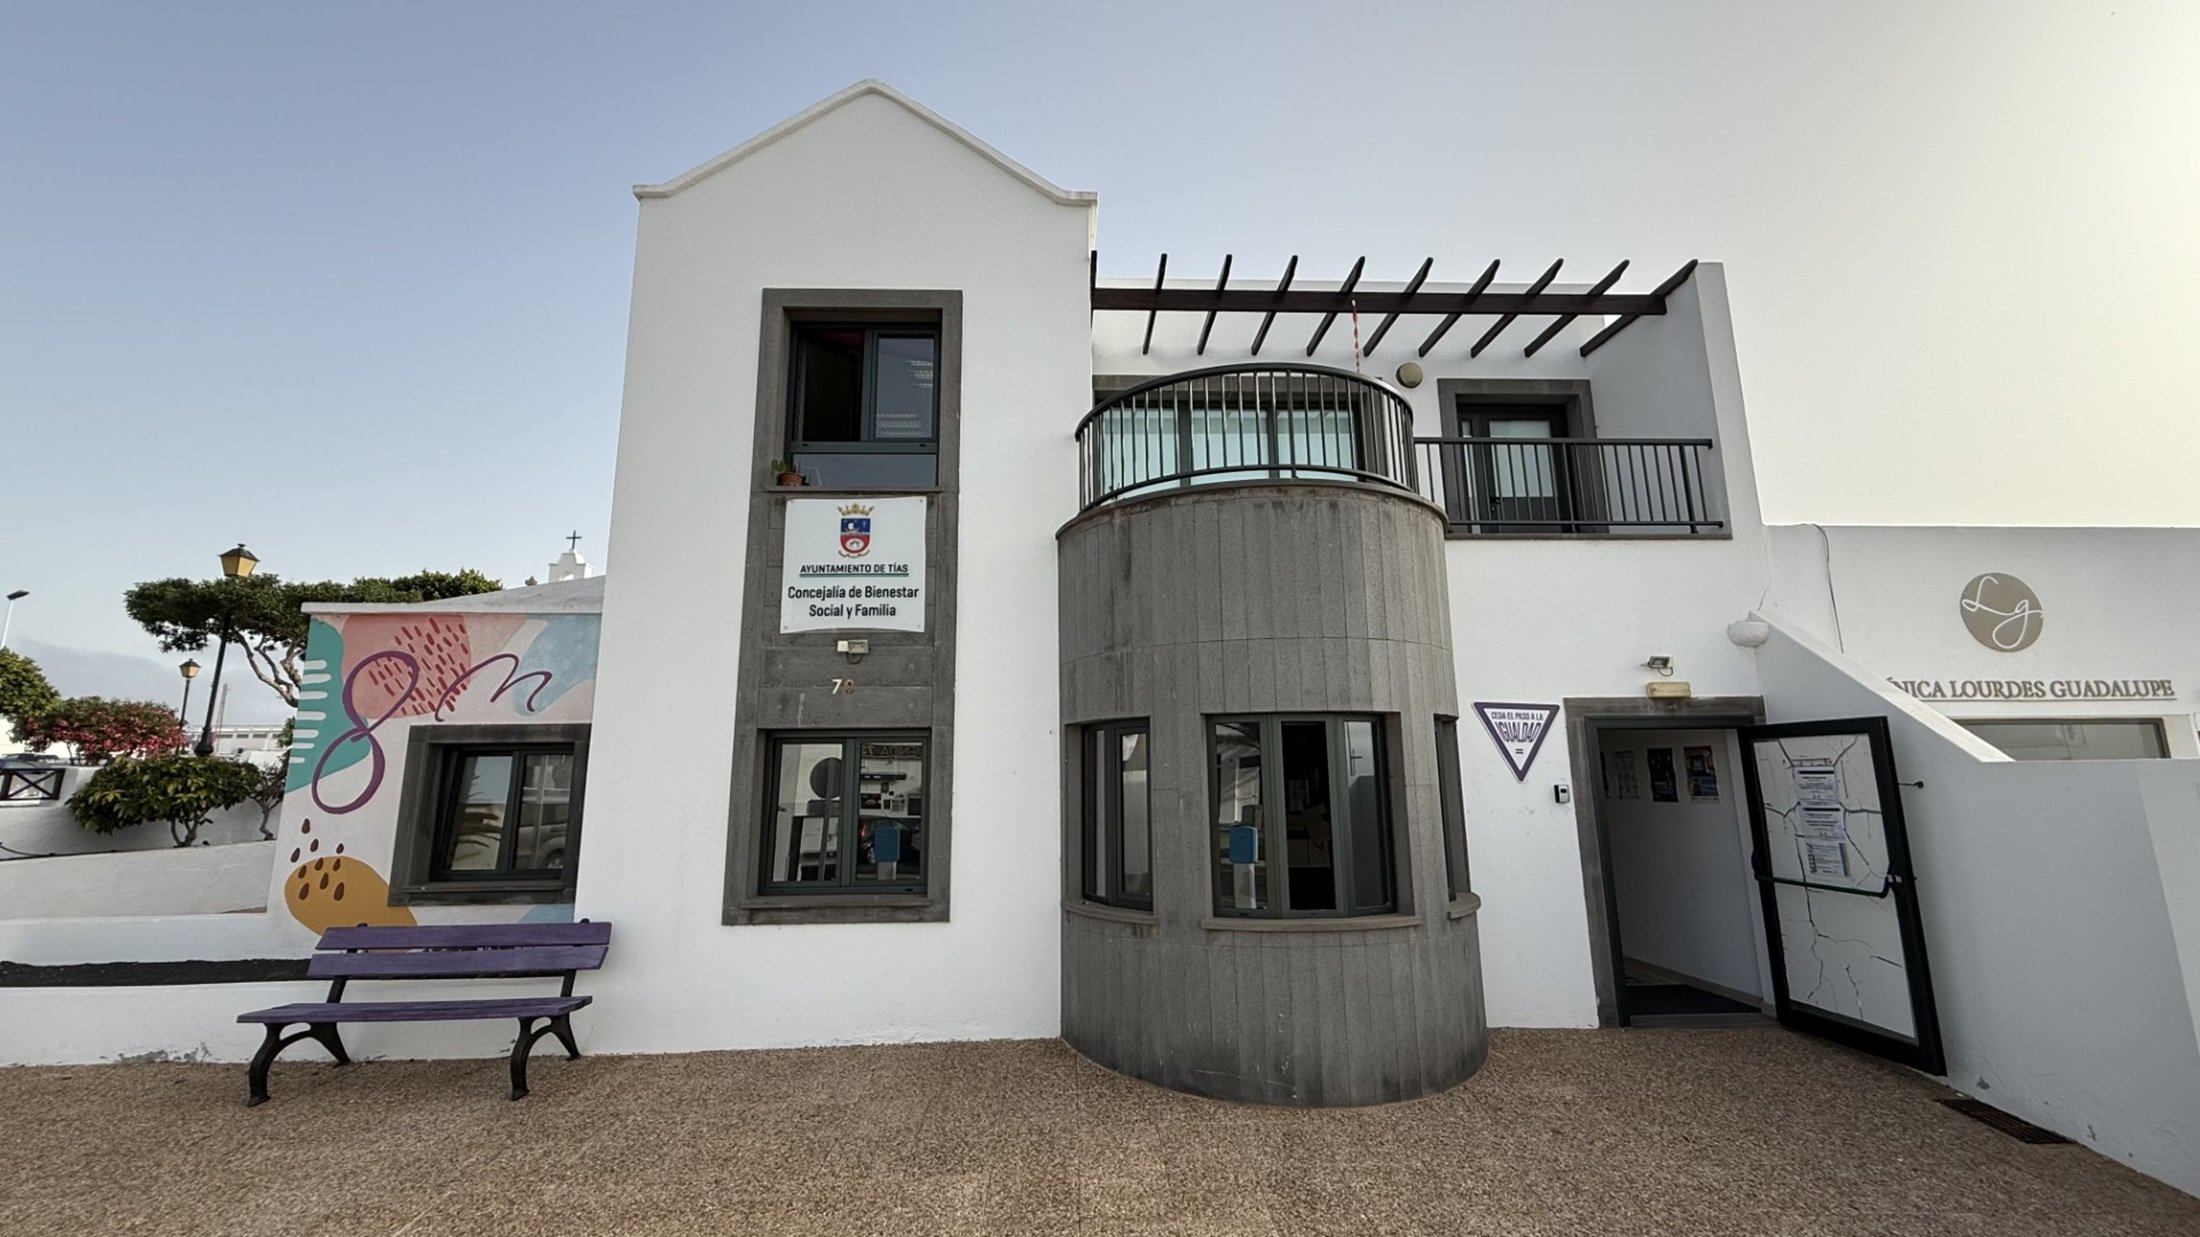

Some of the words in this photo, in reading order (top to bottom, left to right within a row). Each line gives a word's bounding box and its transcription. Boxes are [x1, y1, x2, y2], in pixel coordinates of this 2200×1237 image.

[800, 564, 872, 573] AYUNTAMIENTO
[874, 564, 885, 573] DE
[888, 562, 908, 573] TÍAS
[788, 585, 846, 601] Concejalía
[848, 586, 862, 598] de
[864, 585, 919, 598] Bienestar
[809, 604, 843, 617] Social
[846, 607, 853, 620] y
[855, 604, 896, 616] Familia
[1949, 680, 2046, 698] LOURDES
[2049, 679, 2175, 698] GUADALUPE
[1491, 712, 1506, 720] CEDA
[1508, 712, 1514, 720] EL
[1515, 712, 1530, 721] PASO
[1536, 713, 1543, 721] LA
[1495, 722, 1542, 742] IGUALDAD
